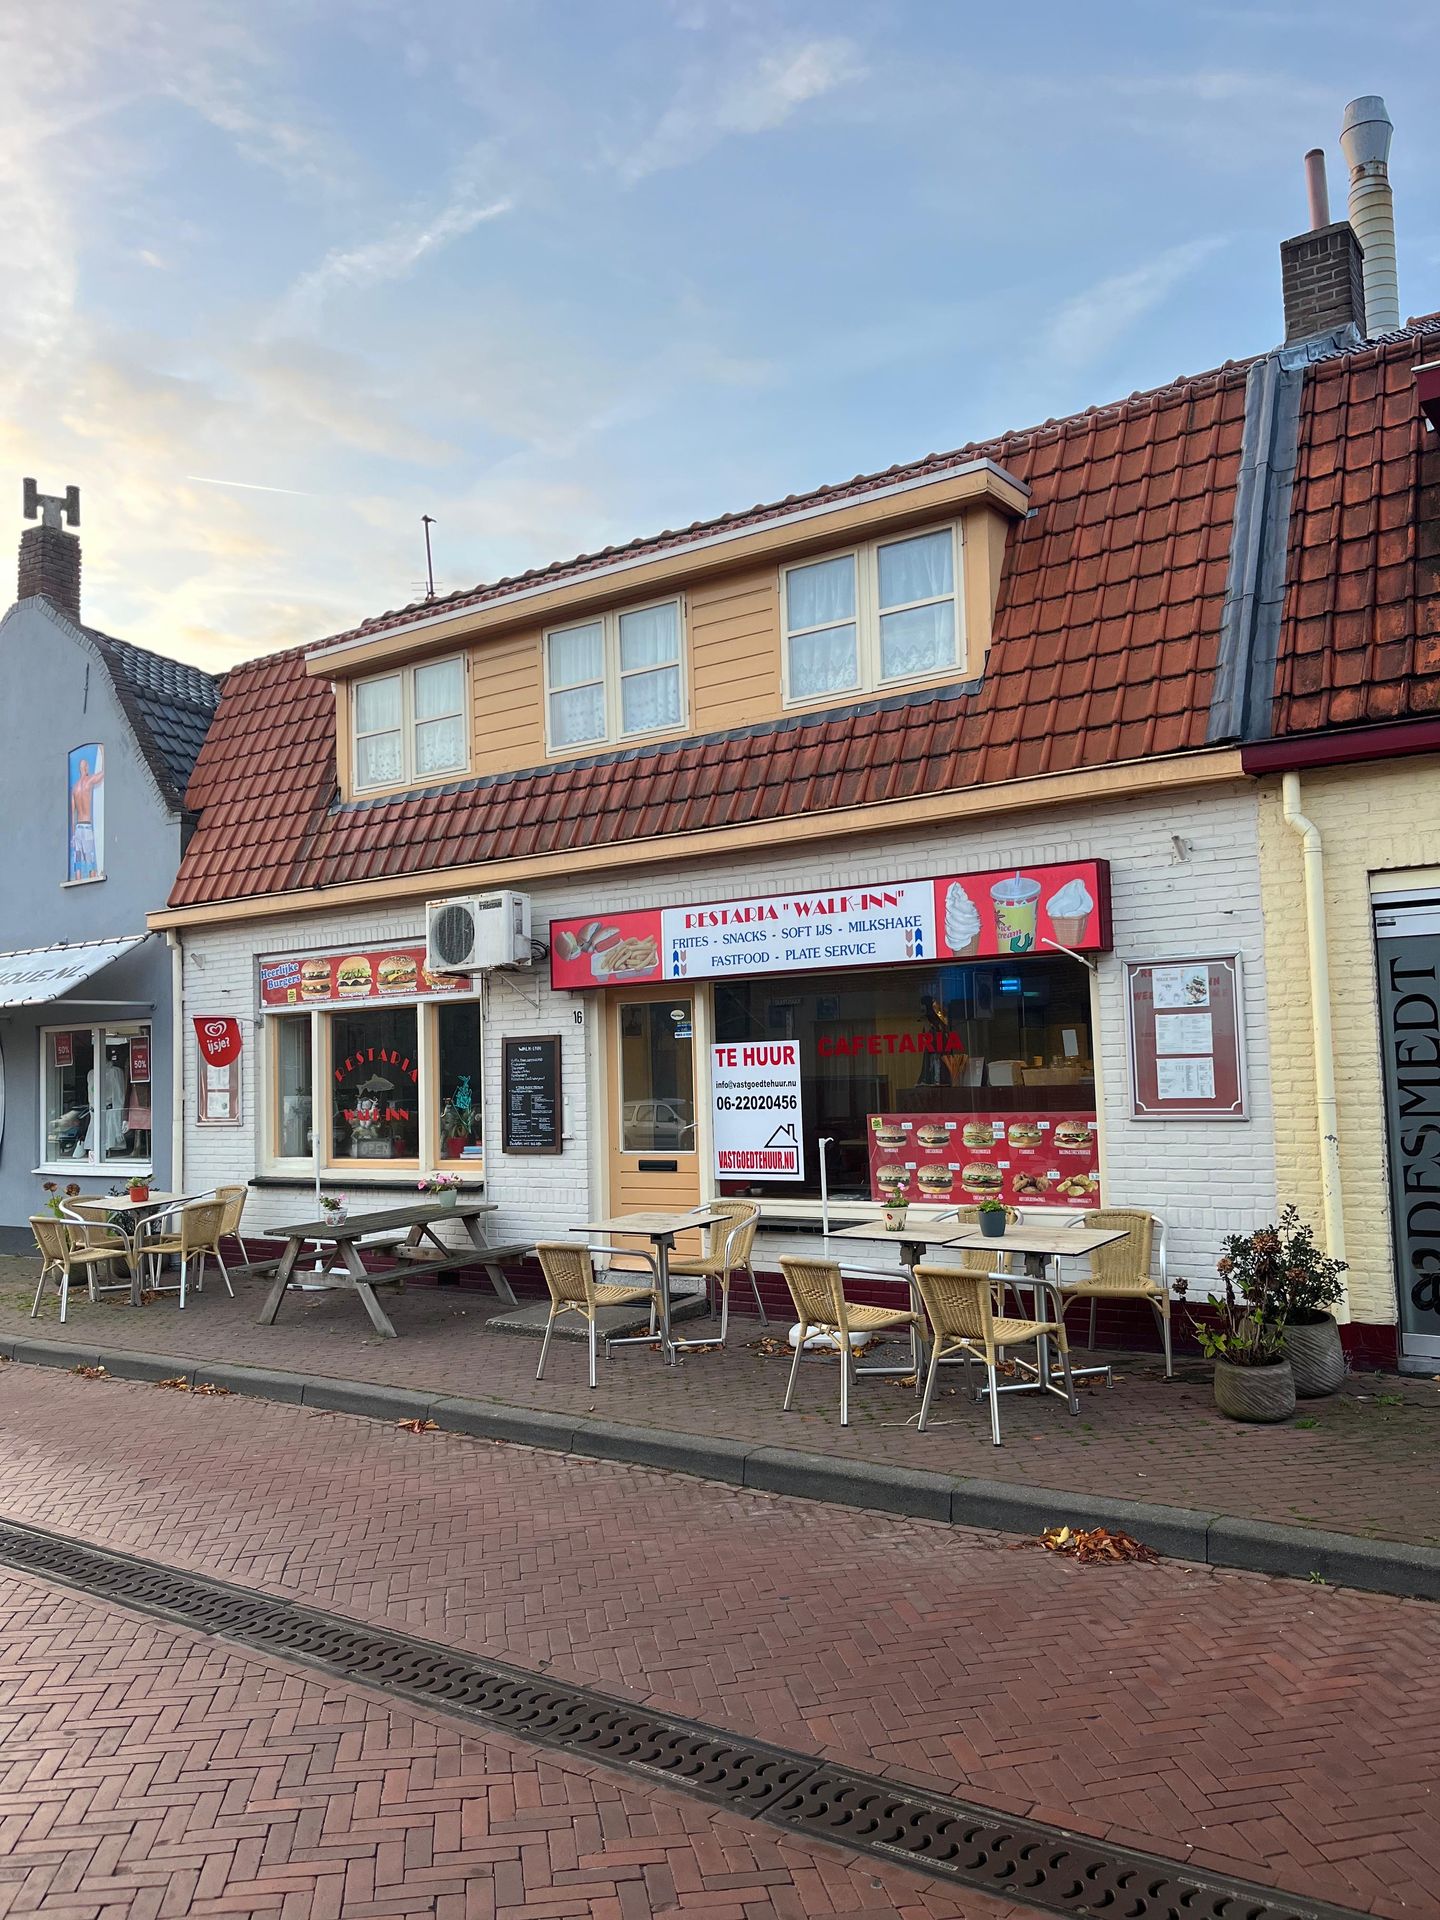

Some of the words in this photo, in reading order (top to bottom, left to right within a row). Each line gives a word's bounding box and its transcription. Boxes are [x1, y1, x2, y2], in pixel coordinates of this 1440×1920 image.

[685, 903, 779, 929] RESTARIA
[672, 936, 709, 950] FRITES
[722, 930, 767, 945] SNACKS
[781, 927, 811, 940] SOFT
[815, 924, 833, 936] IJS
[848, 915, 923, 933] MILKSHAKE
[711, 952, 770, 967] FASTFOOD
[785, 947, 821, 961] PLATE
[824, 942, 876, 958] SERVICE
[261, 962, 299, 980] Heerlijke
[267, 974, 301, 990] Burgers
[573, 1010, 583, 1024] 16
[206, 1037, 230, 1055] ijsje?
[817, 1030, 965, 1057] CAFETARIA
[134, 1059, 147, 1069] 50%
[335, 1048, 418, 1083] RESTARIA
[715, 1048, 738, 1068] TE
[743, 1046, 796, 1067] HUUR
[715, 1080, 797, 1090] info@vastgoedtehuur.nu
[716, 1095, 798, 1110] 06-22020456
[360, 1142, 389, 1155] OPEN
[718, 1151, 795, 1169] VASTGOEDTEHUUR.NU
